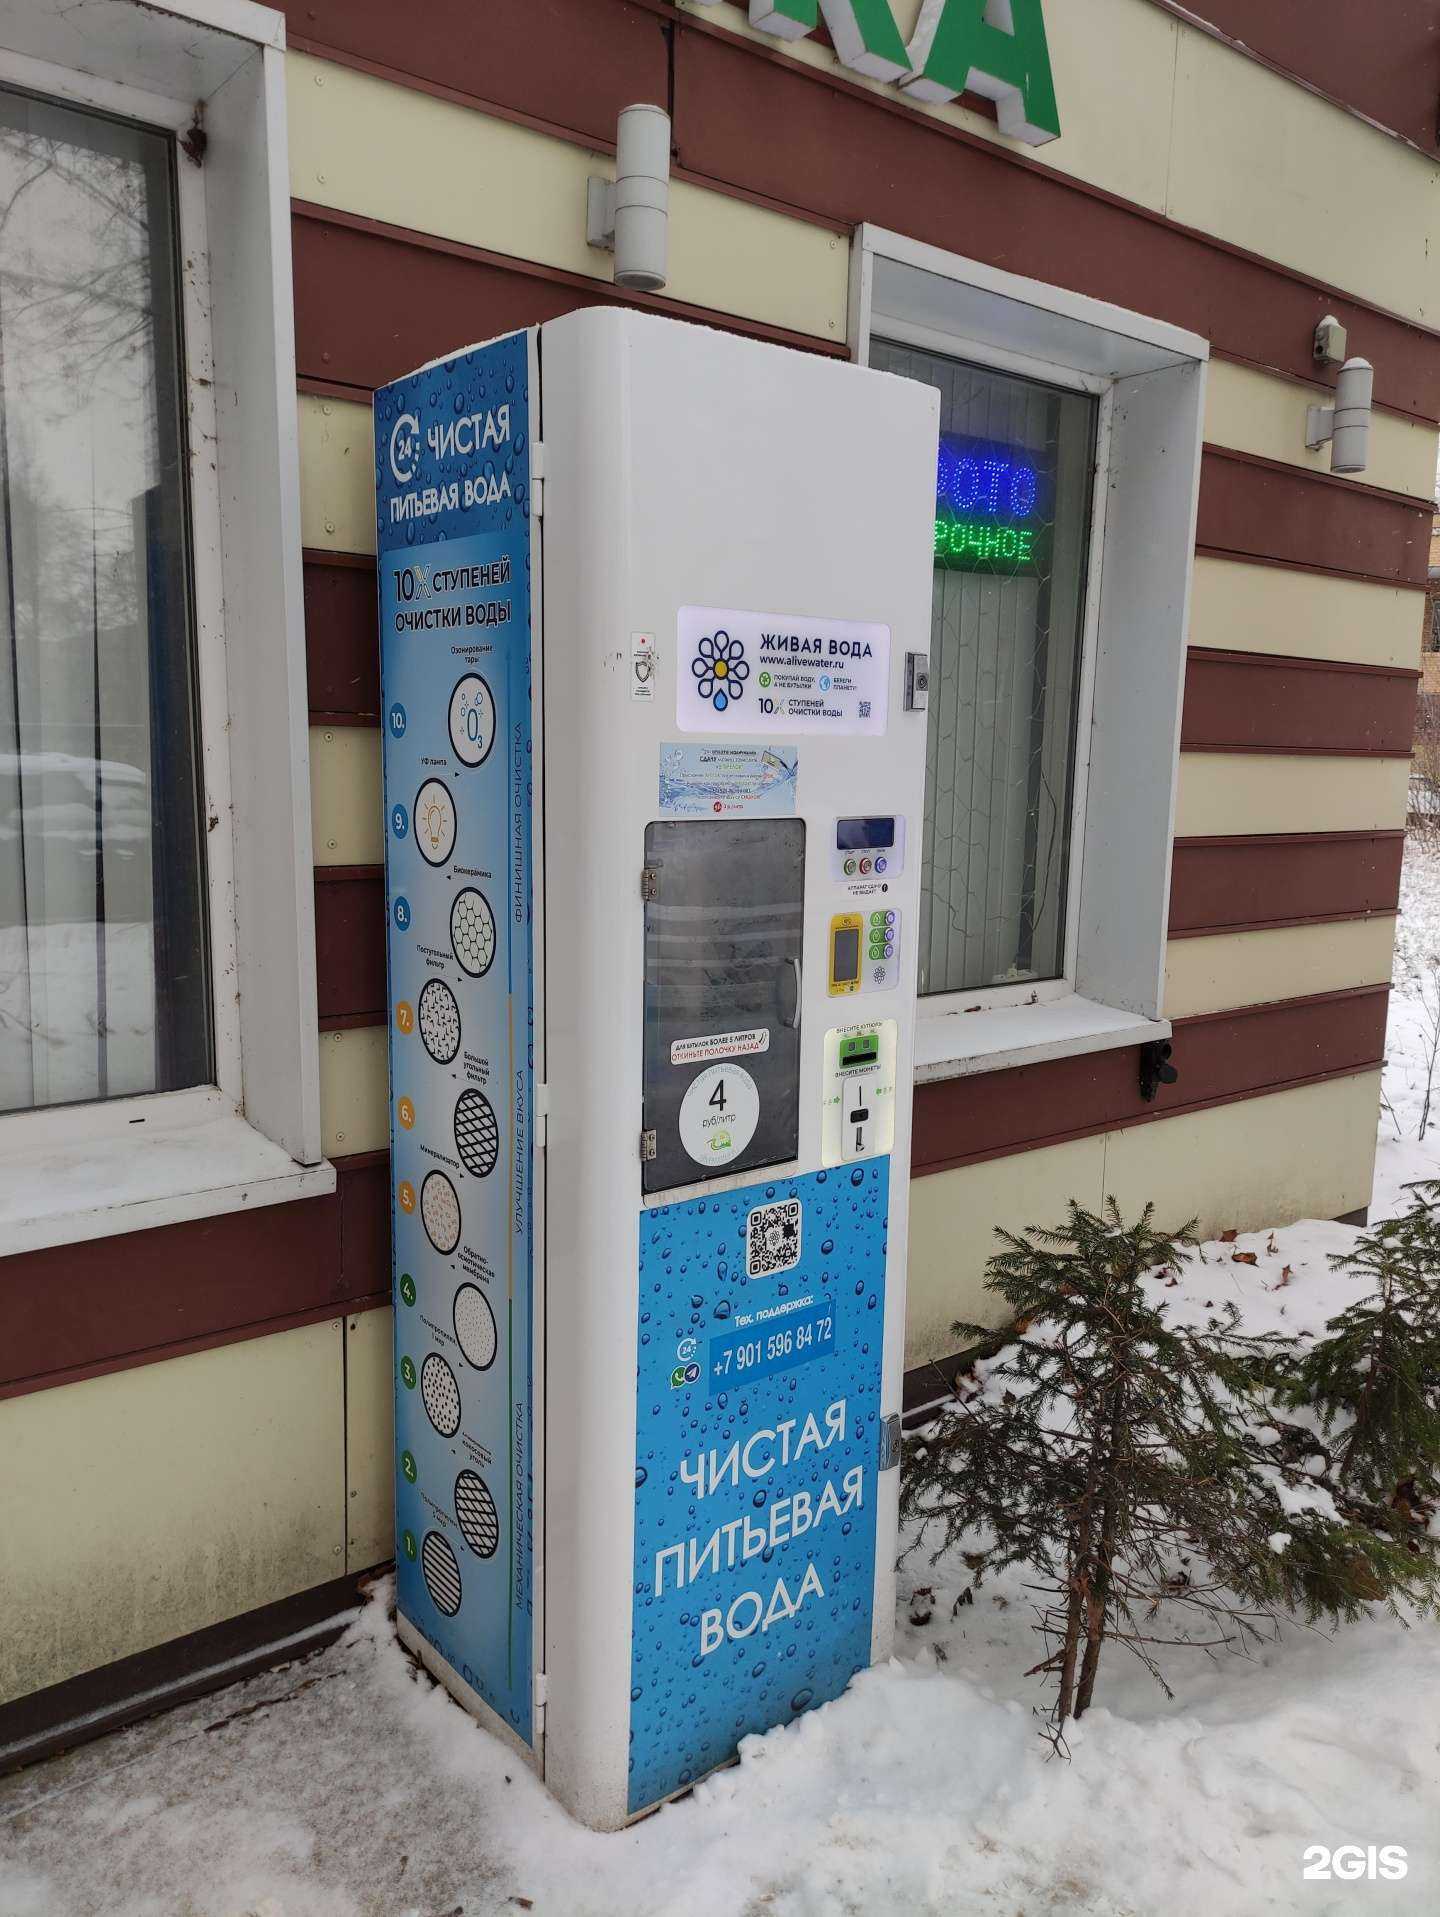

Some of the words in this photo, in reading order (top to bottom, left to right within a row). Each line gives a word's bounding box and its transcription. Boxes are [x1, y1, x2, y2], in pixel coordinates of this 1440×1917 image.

[427, 404, 510, 460] ЧИСТАЯ
[390, 482, 459, 523] ПИТЬЕВАЯ
[464, 471, 511, 507] ВОДА
[937, 455, 1036, 516] ОТО
[432, 554, 511, 593] СТУПЕНЕЙ
[395, 606, 461, 632] ОЧИСТКИ
[465, 599, 511, 626] ВОДЫ
[759, 656, 845, 669] www.alivewater.ru
[760, 633, 822, 652] ЖИВАЯ
[829, 639, 873, 659] ВОДА
[788, 699, 824, 708] СТУПЕНЕЙ
[788, 708, 821, 716] ОЧИСТКИ
[822, 709, 843, 717] ВОДЫ
[514, 722, 523, 808] ОЧИСТКА
[514, 813, 523, 923] ФИНИШНАЯ
[671, 1049, 704, 1061] ОТКИНЬТЕ
[704, 1045, 736, 1057] ПОЛОЧКУ
[737, 1042, 759, 1052] НАЗАД
[734, 1033, 756, 1042] ЛИТРОВ
[515, 1070, 524, 1125] ВКУСА
[709, 1079, 727, 1111] 4
[514, 1128, 524, 1234] УЛУЧШЕНИЕ
[735, 1314, 754, 1328] Тех.
[756, 1295, 814, 1321] поддержка:
[713, 1349, 733, 1377] +7
[736, 1340, 761, 1370] 901
[766, 1330, 792, 1360] 596
[796, 1323, 813, 1350] 84
[816, 1316, 832, 1343] 72
[515, 1402, 524, 1477] ОЧИСТКА
[680, 1399, 847, 1500] ЧИСТАЯ
[514, 1479, 524, 1610] МЕХАНИЧЕСКАЯ
[654, 1465, 863, 1597] ПИТЬЕВАЯ
[700, 1562, 825, 1657] ВОДА
